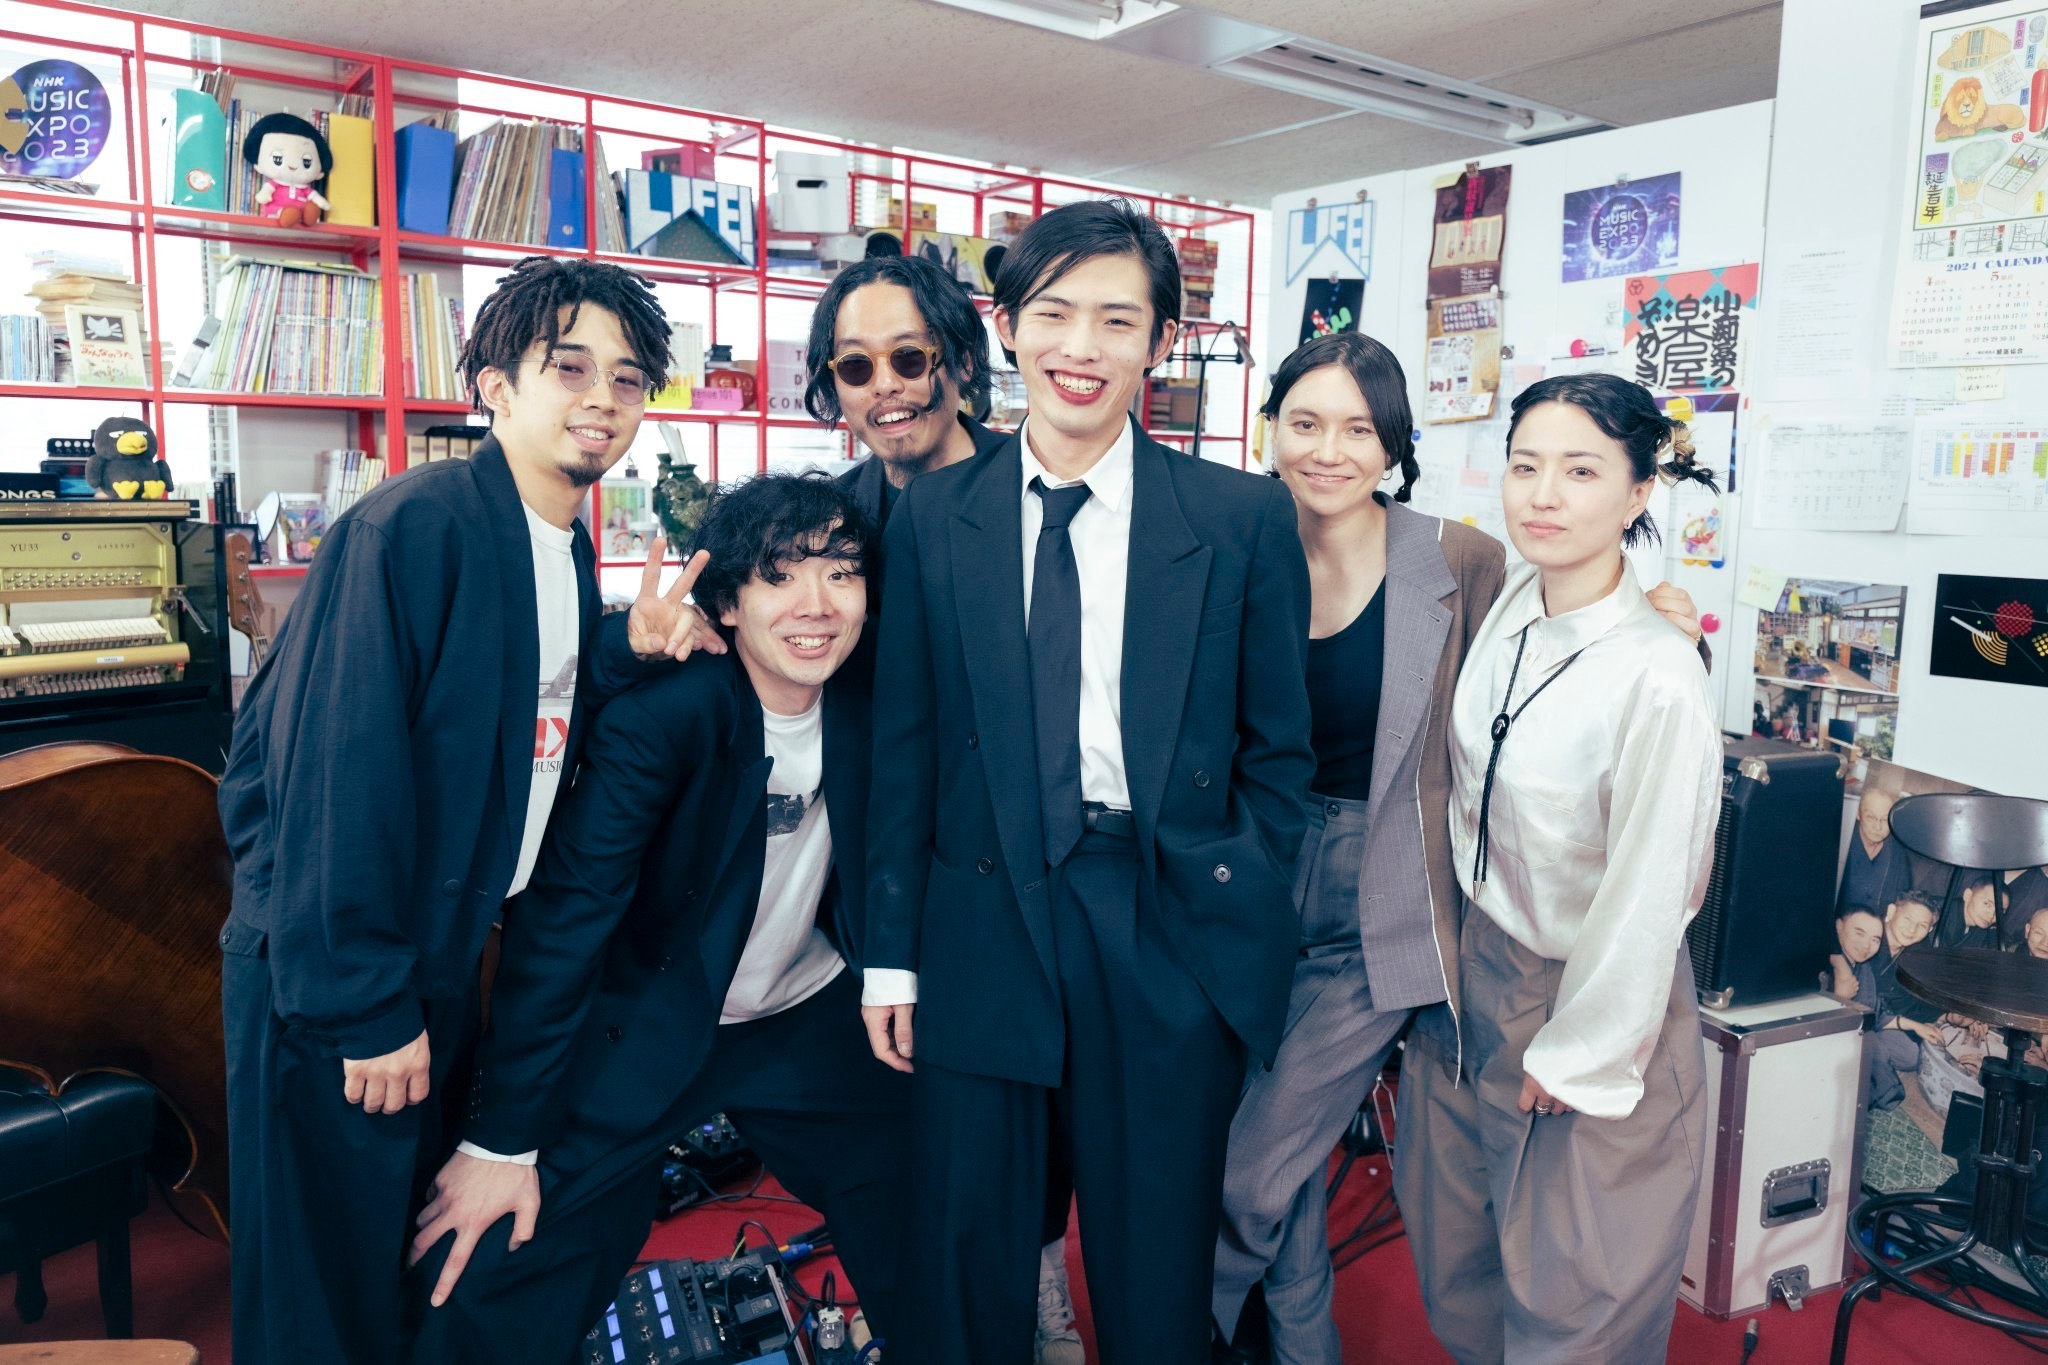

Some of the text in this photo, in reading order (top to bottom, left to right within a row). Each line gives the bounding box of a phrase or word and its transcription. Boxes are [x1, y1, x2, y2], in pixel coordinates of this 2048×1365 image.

[33, 77, 64, 87] NHK
[29, 89, 90, 112] USIC
[27, 114, 91, 137] XPO
[1599, 208, 1640, 226] MUSIC
[1599, 222, 1640, 240] EXPO
[1599, 235, 1639, 252] 2023
[1946, 262, 1977, 272] 2024
[1990, 271, 1999, 281] 5
